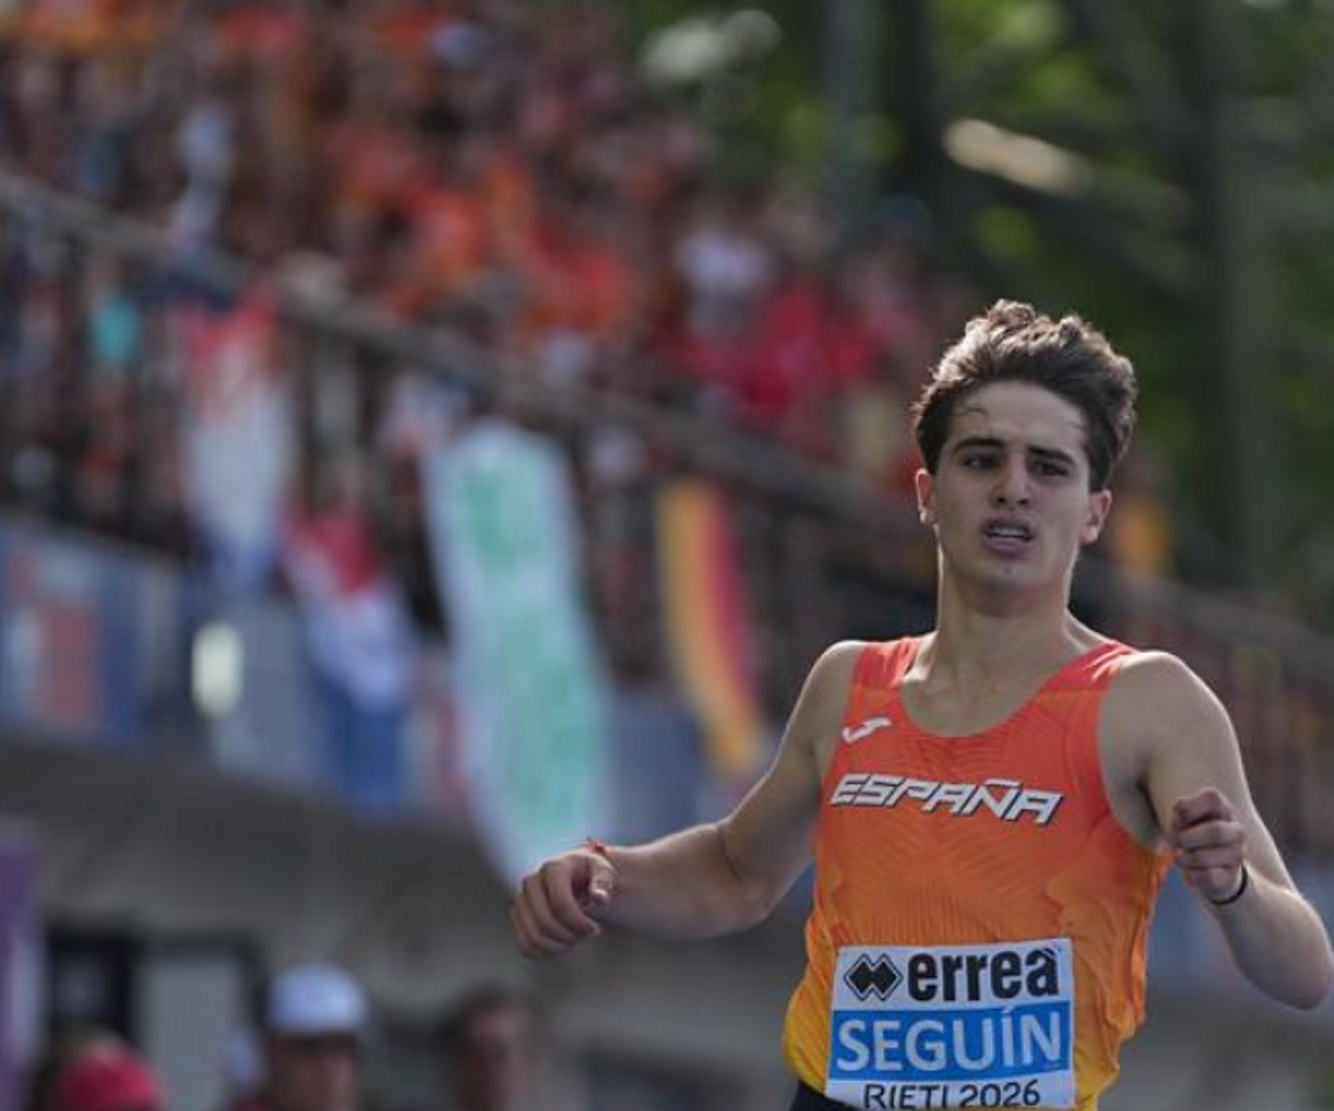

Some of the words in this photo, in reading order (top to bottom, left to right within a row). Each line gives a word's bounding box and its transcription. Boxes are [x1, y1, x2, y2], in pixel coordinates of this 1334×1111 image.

[828, 773, 1064, 825] ESPAÑA
[837, 1008, 1062, 1072] SEGUÍN
[864, 1083, 949, 1111] RIETI
[960, 1079, 1042, 1109] 2026
